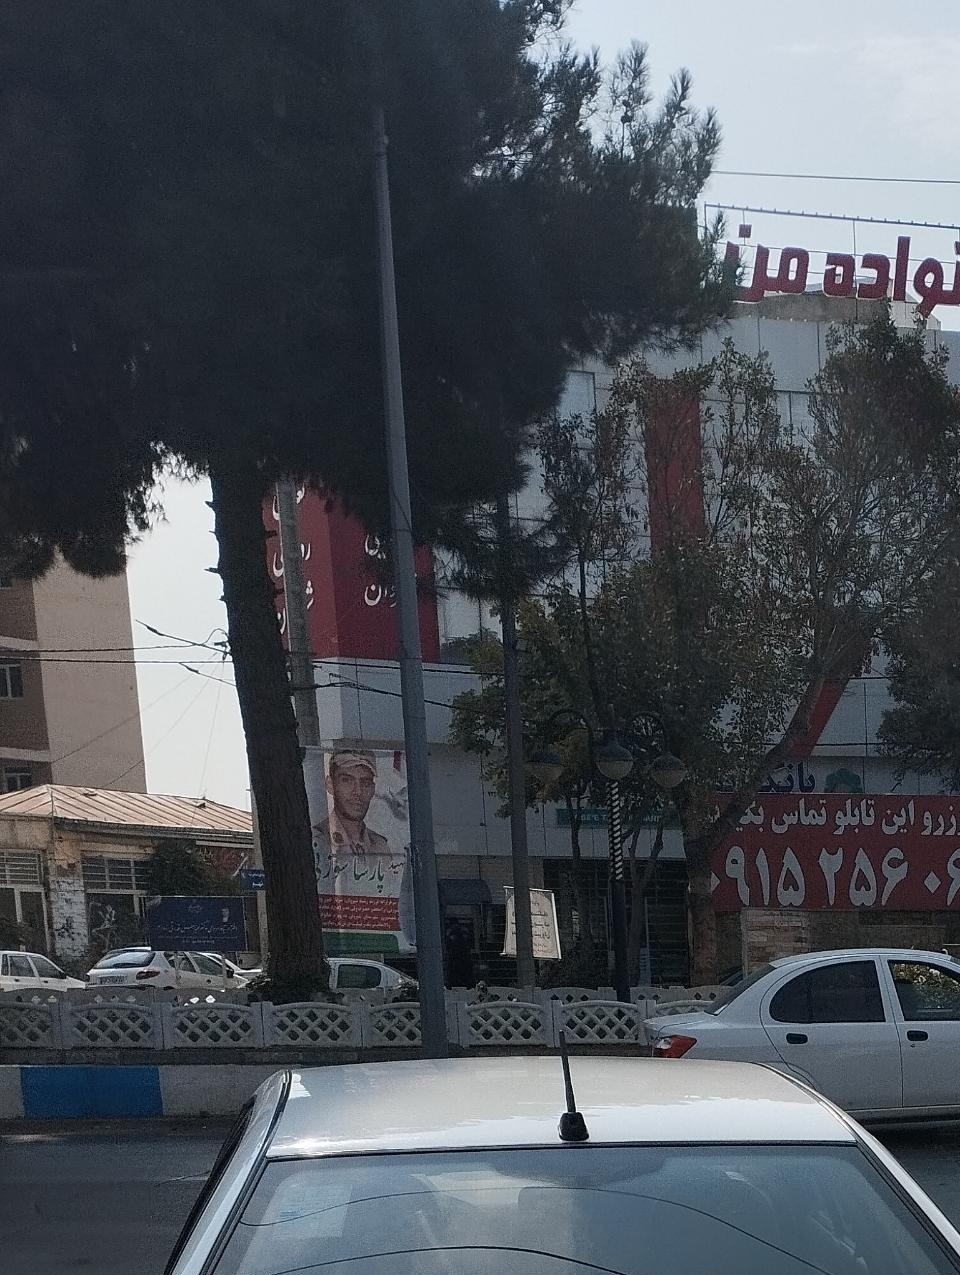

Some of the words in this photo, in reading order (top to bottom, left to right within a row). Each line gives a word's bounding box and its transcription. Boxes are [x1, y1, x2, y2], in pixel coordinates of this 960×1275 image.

[724, 224, 809, 303] من
[771, 798, 826, 834] تماس
[833, 798, 875, 835] تابلو
[881, 801, 915, 835] این
[818, 846, 908, 907] ۲۵۶
